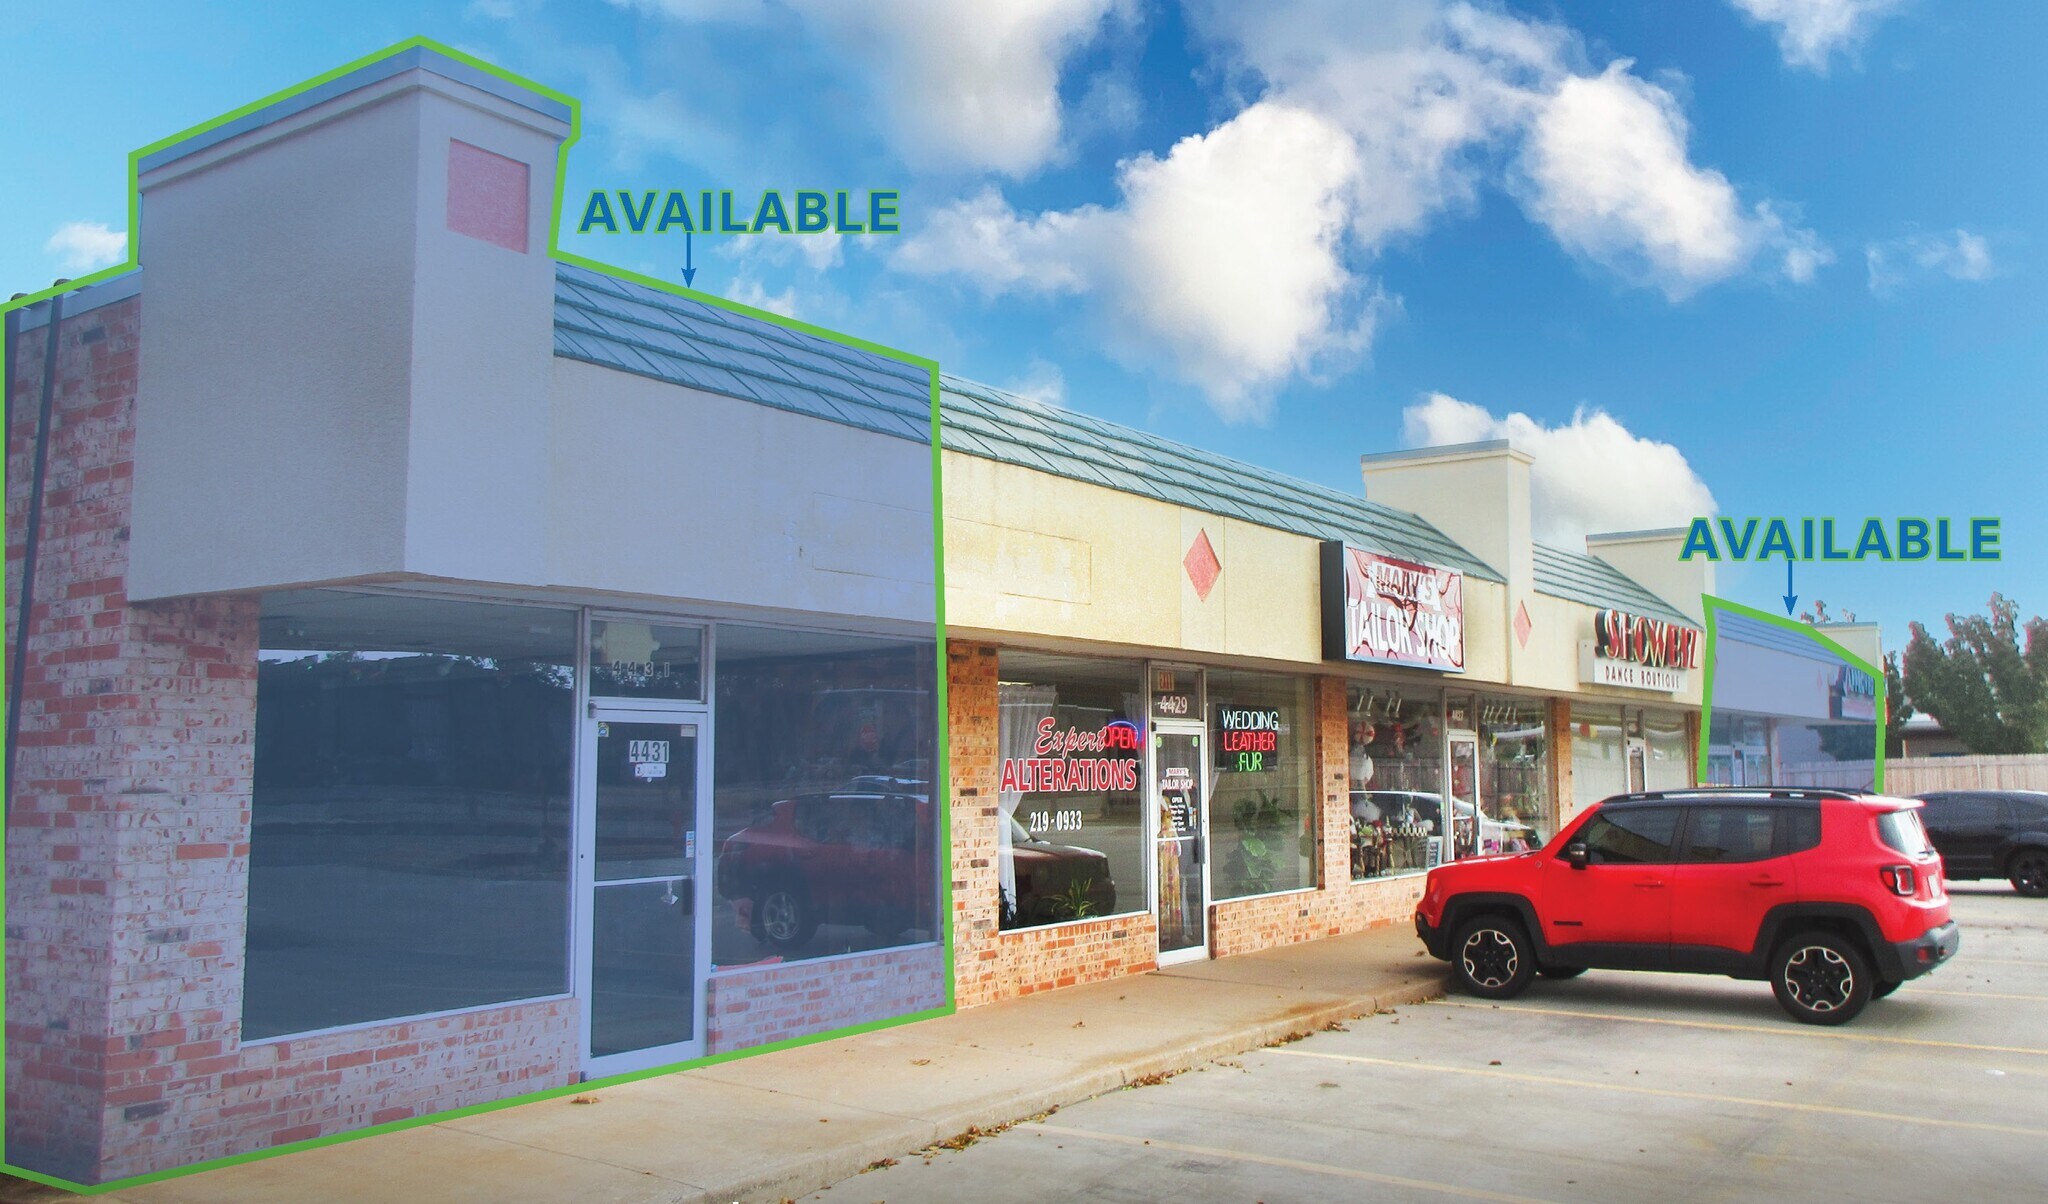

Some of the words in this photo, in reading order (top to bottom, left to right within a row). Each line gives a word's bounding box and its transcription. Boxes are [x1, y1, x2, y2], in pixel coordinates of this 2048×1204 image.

[1348, 598, 1414, 655] TAILOR
[1415, 610, 1460, 660] SHOP
[1605, 666, 1633, 683] DANCE
[1641, 671, 1680, 689] BOUTIQUE
[1160, 696, 1187, 714] 4429
[1221, 710, 1279, 731] WEDDING
[1034, 717, 1107, 758] Expert
[1105, 726, 1138, 749] OPEN
[1224, 731, 1276, 751] LEATHER
[631, 741, 668, 762] 4431
[1239, 752, 1263, 771] FUR
[1000, 758, 1137, 793] ALTERATIONS
[1161, 779, 1179, 790] TAILOR
[1180, 779, 1194, 790] SHOP
